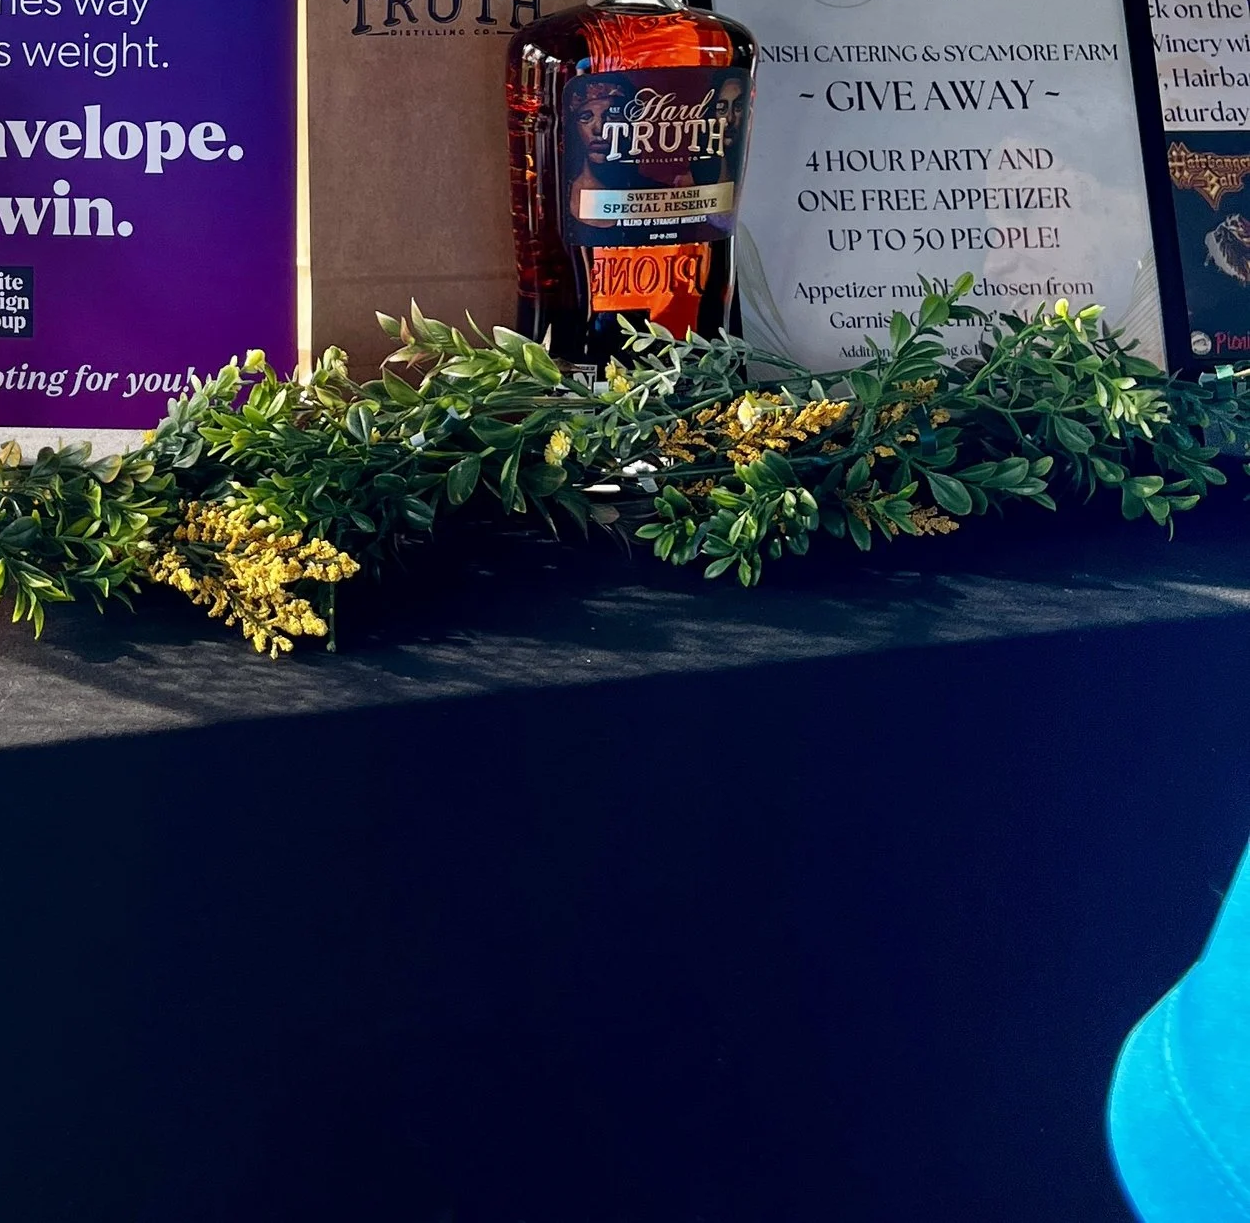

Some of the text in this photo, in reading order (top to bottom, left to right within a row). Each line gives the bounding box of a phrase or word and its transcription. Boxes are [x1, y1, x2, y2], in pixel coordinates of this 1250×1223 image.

[1174, 3, 1203, 19] on
[21, 32, 169, 77] weight.
[758, 44, 1118, 62] NISH CATERING & SYCAMORE FARM
[624, 88, 715, 122] Hard
[826, 81, 915, 112] GIVE
[924, 80, 1035, 110] AWAY
[602, 118, 728, 161] TRUTH
[805, 148, 1054, 172] 4 HOUR PARTY AND
[603, 198, 717, 214] SPECIAL RESERVE
[627, 190, 700, 202] SWEET MASH
[798, 187, 1071, 212] ONE FREE APPETIZER
[827, 227, 1060, 254] UP TO 50 PEOPLE!
[794, 282, 886, 304] Appetizer
[973, 278, 1042, 296] chosen
[1047, 277, 1093, 296] from
[829, 309, 900, 330] Garnis
[69, 364, 118, 396] for
[123, 367, 195, 397] you!
